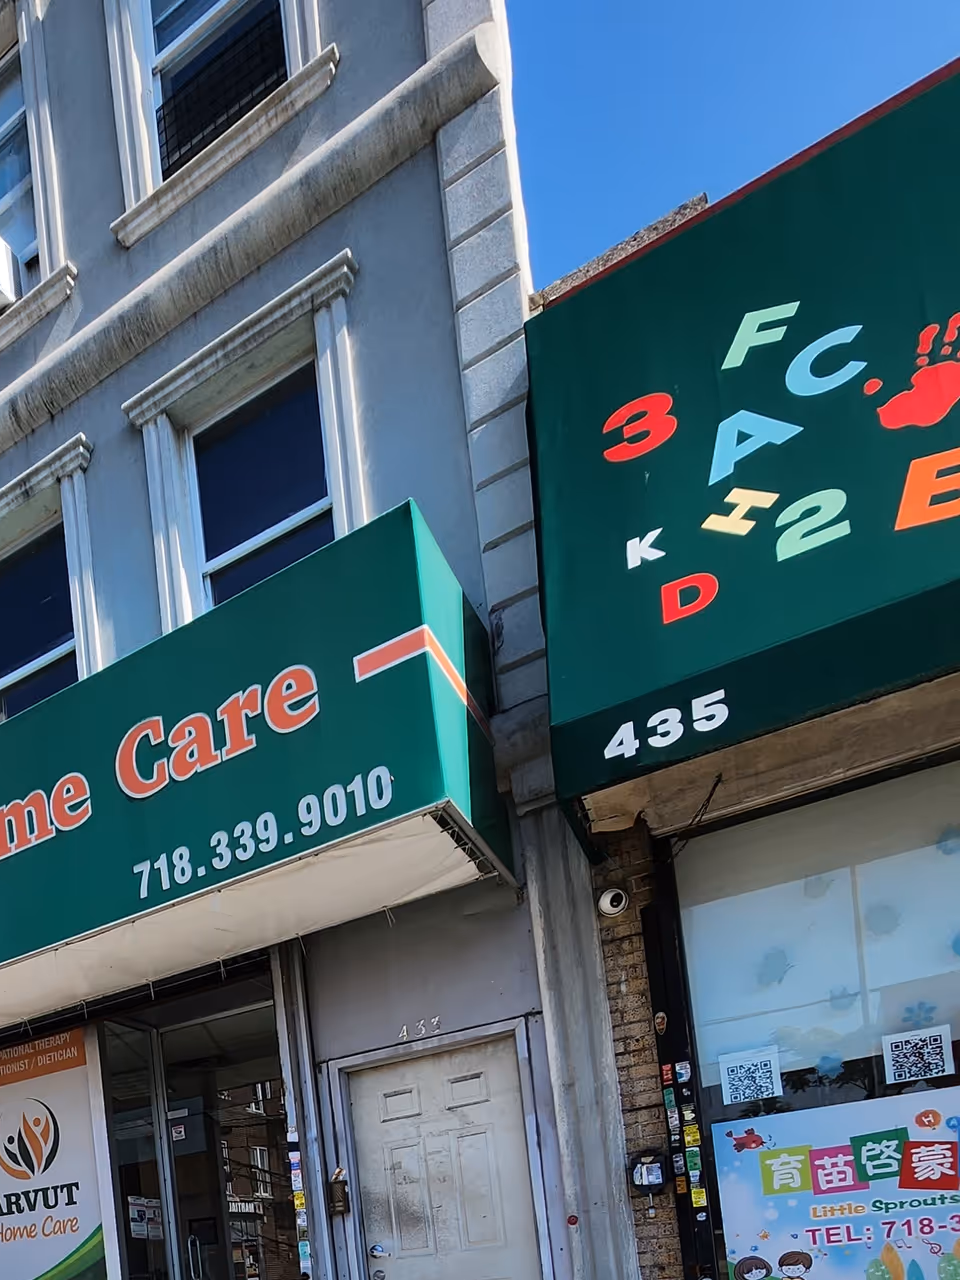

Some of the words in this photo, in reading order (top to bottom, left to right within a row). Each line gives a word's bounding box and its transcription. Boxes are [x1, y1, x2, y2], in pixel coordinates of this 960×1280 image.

[721, 300, 800, 370] F
[785, 325, 868, 396] C
[602, 392, 678, 463] 3
[708, 409, 805, 486] A
[626, 527, 667, 570] K
[775, 488, 851, 562] 2
[660, 572, 719, 625] D
[115, 664, 320, 799] Care
[604, 688, 729, 761] 435
[133, 765, 393, 899] 718.339.9010
[34, 1032, 71, 1050] THERAPY
[37, 1046, 78, 1067] DIETICIAN
[41, 1215, 80, 1237] Care
[806, 1226, 872, 1246] TEL:
[811, 1203, 866, 1219] Little
[871, 1194, 960, 1213] Sprouts
